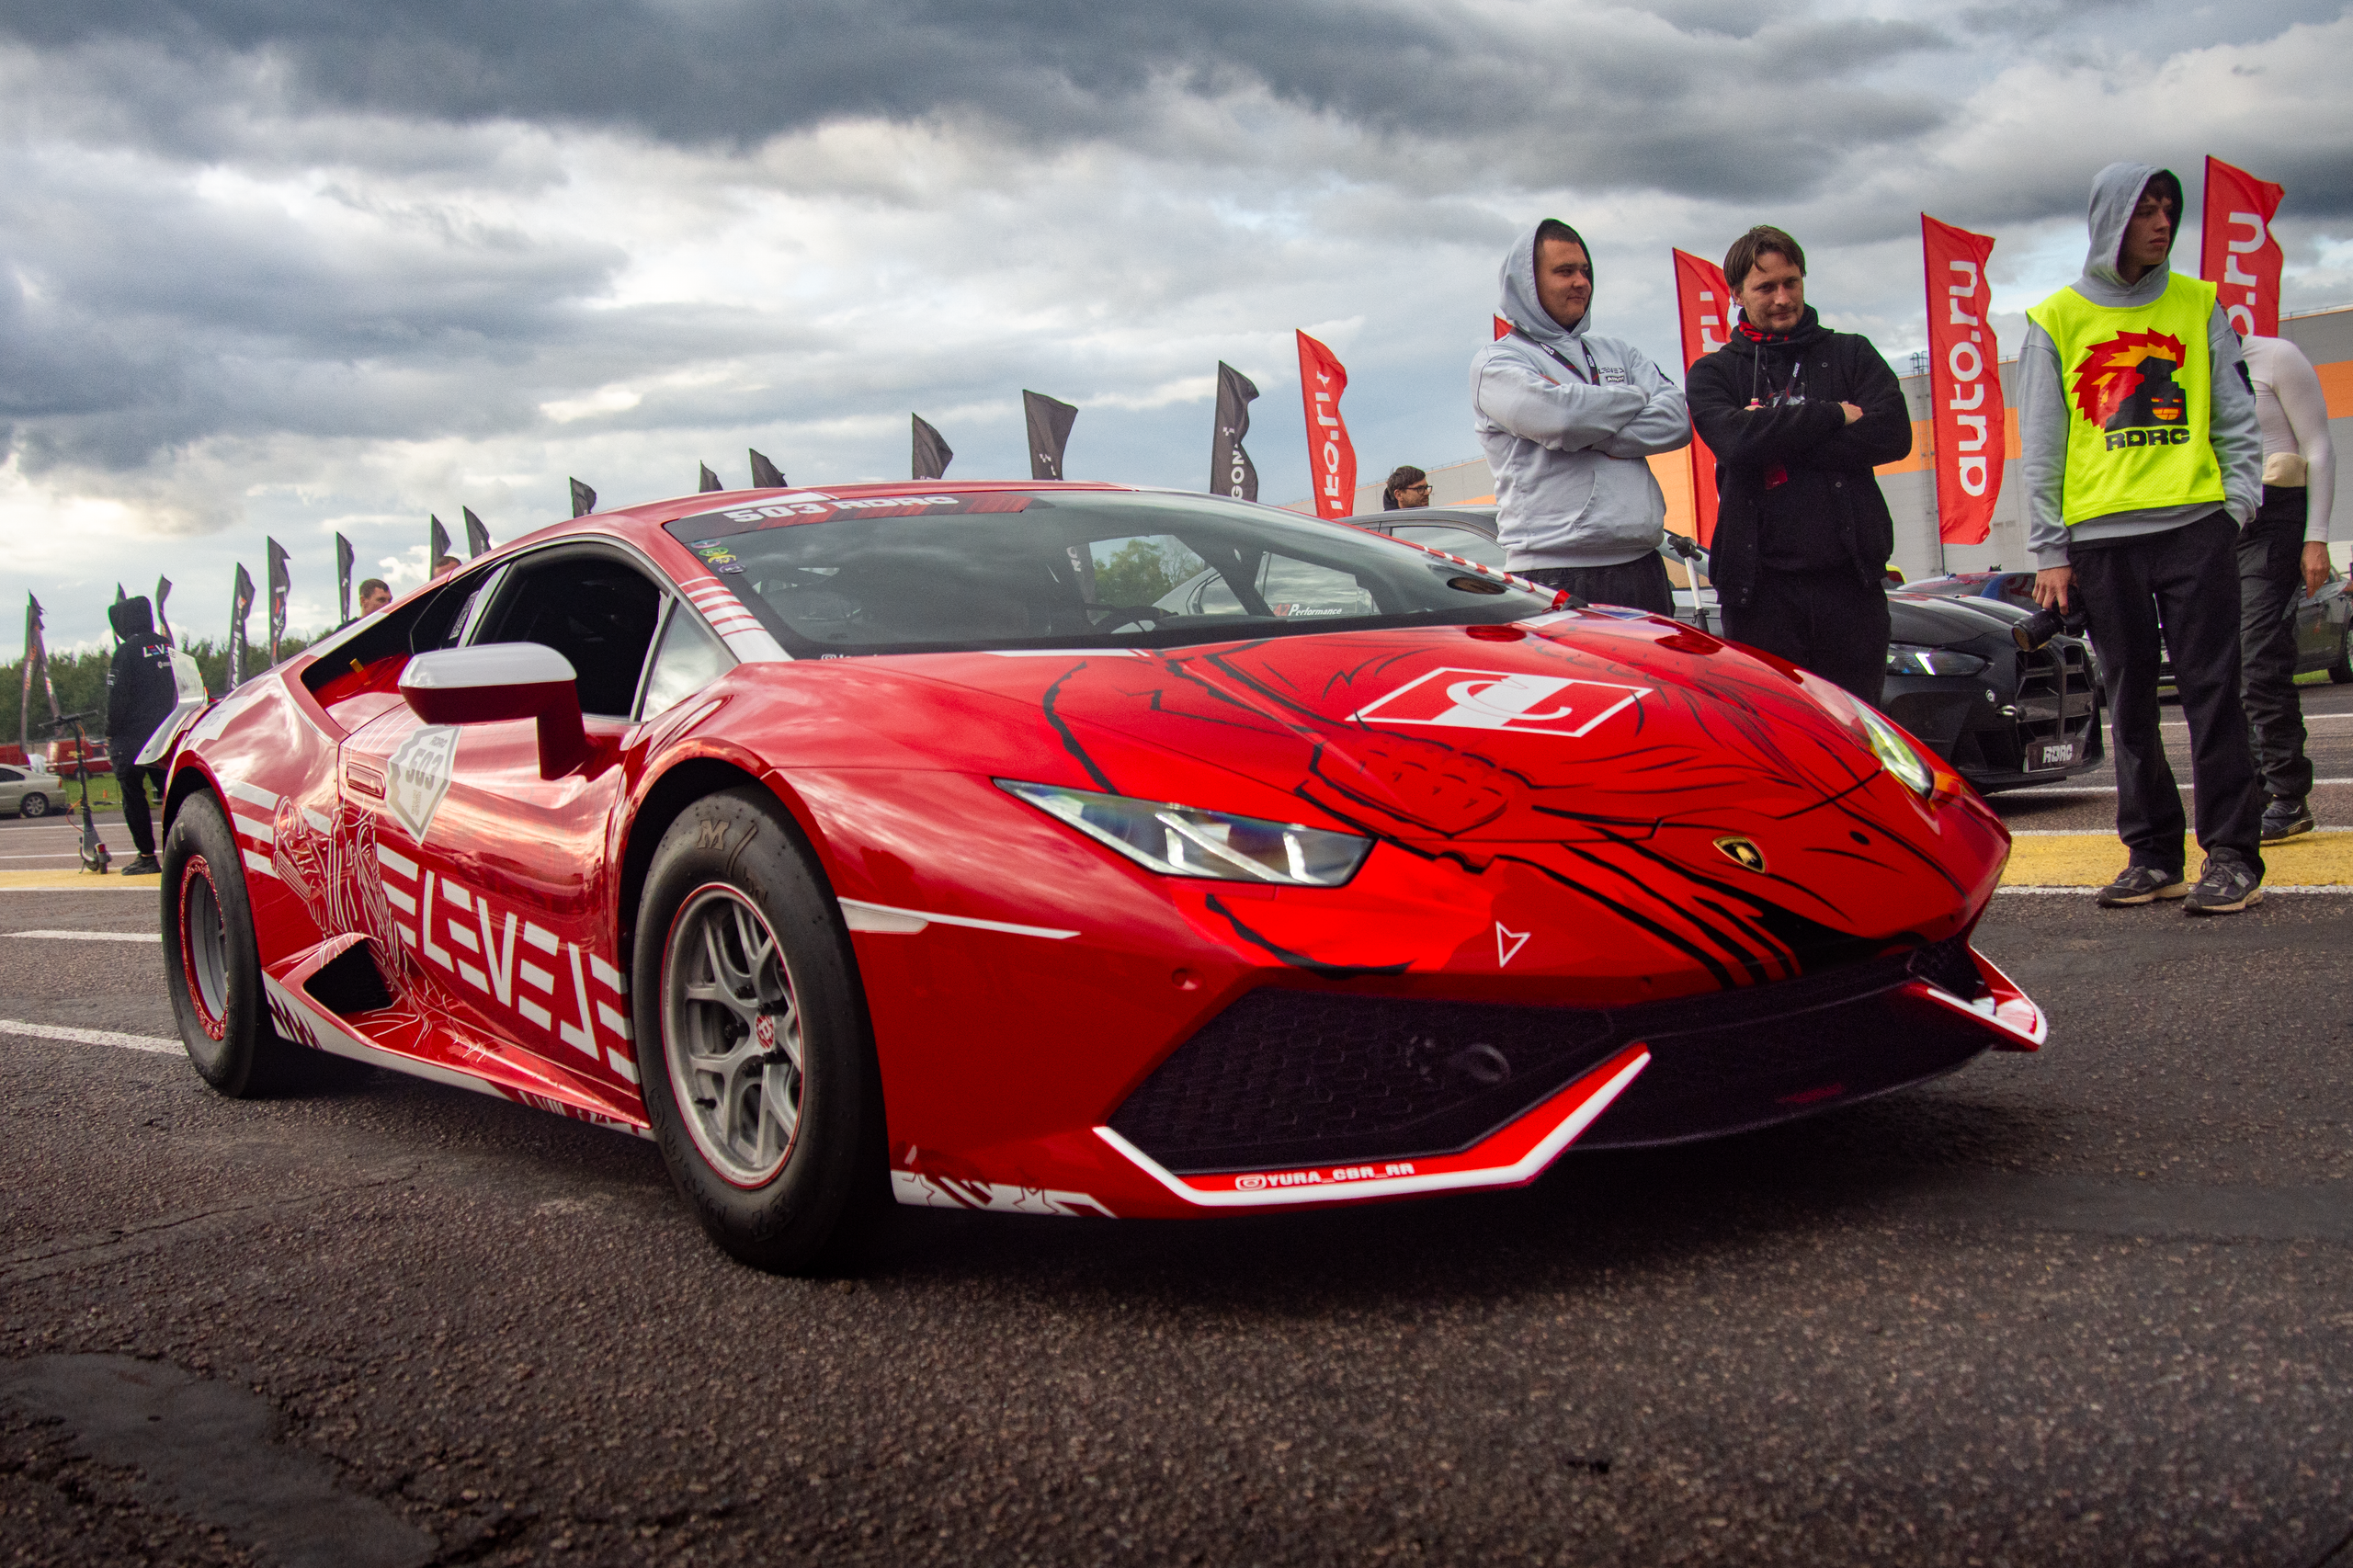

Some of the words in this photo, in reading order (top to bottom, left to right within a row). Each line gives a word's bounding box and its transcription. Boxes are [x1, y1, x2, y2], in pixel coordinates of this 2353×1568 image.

[1949, 260, 1989, 497] auto.ru
[2105, 428, 2190, 451] RDRC
[722, 504, 828, 522] 503
[829, 496, 960, 510] RDRC
[2042, 744, 2074, 764] RDRC
[404, 747, 444, 791] 503
[1267, 1163, 1415, 1187] YURA_CBR_RR
